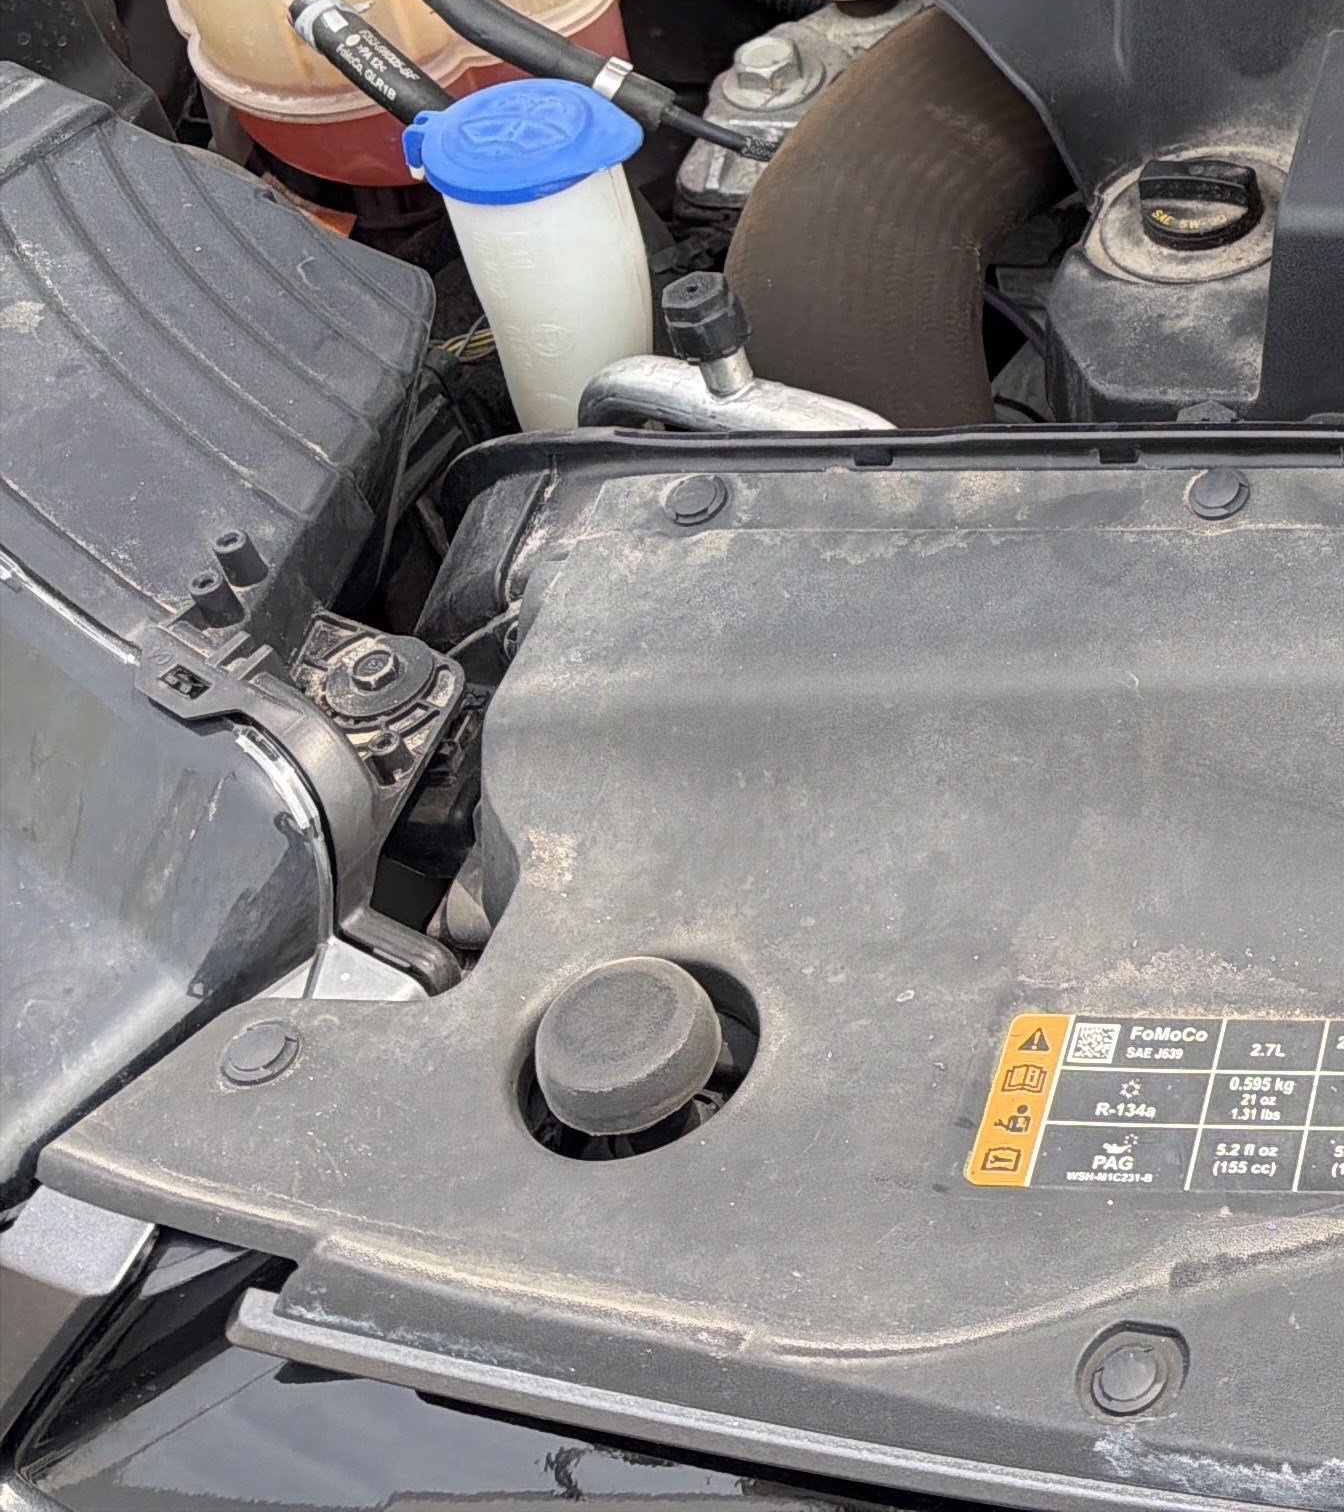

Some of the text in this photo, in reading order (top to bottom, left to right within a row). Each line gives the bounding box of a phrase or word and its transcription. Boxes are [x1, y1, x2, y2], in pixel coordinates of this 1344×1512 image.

[1150, 209, 1175, 226] SAE
[1130, 1026, 1208, 1042] FoMoCo
[1126, 1046, 1184, 1060] SAE J639
[1249, 1043, 1286, 1057] 2.7L
[1229, 1076, 1295, 1094] 0.595 kg
[1240, 1094, 1277, 1106] 21 oz
[1095, 1102, 1157, 1119] R-134a
[1230, 1108, 1281, 1121] 1.31 lbs
[1215, 1143, 1278, 1157] 5.2 fl oz
[1091, 1155, 1135, 1171] PAG
[1212, 1161, 1277, 1177] (155 cc)
